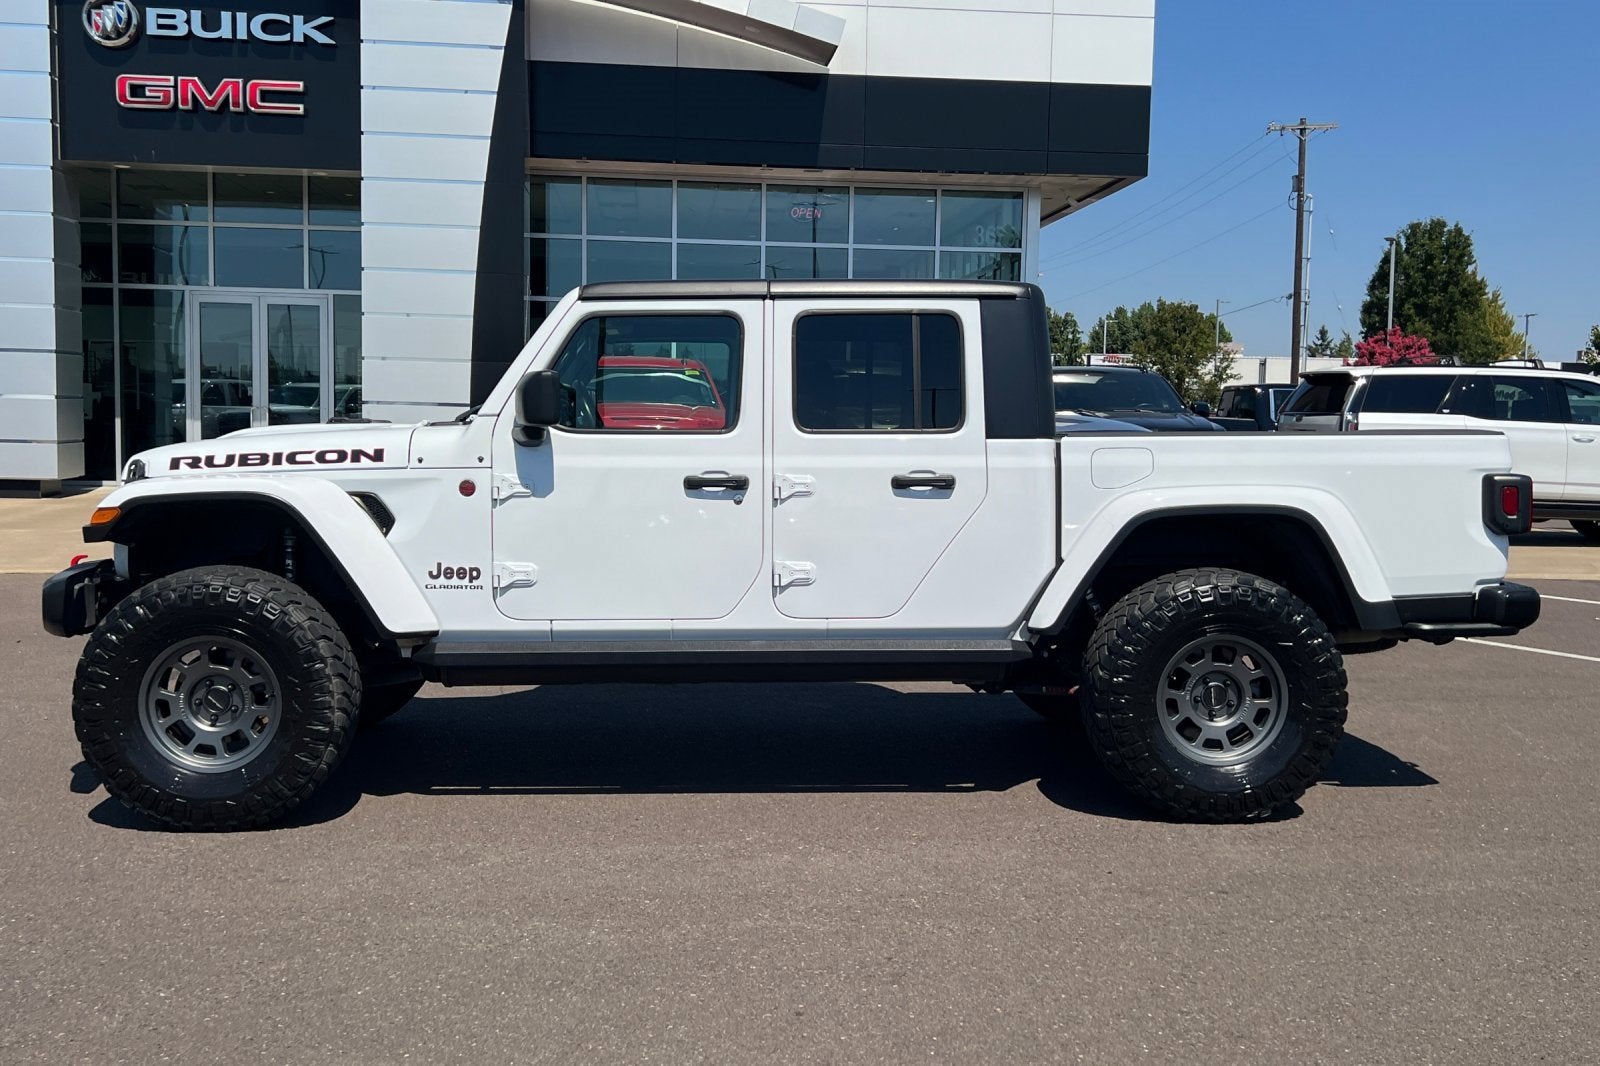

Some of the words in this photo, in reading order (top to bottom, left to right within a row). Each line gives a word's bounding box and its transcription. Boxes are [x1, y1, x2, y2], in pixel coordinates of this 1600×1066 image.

[145, 7, 337, 45] BUICK
[115, 74, 305, 115] GMC
[790, 207, 822, 219] OPEN
[168, 447, 385, 471] RUBICON
[427, 561, 482, 584] Jeep
